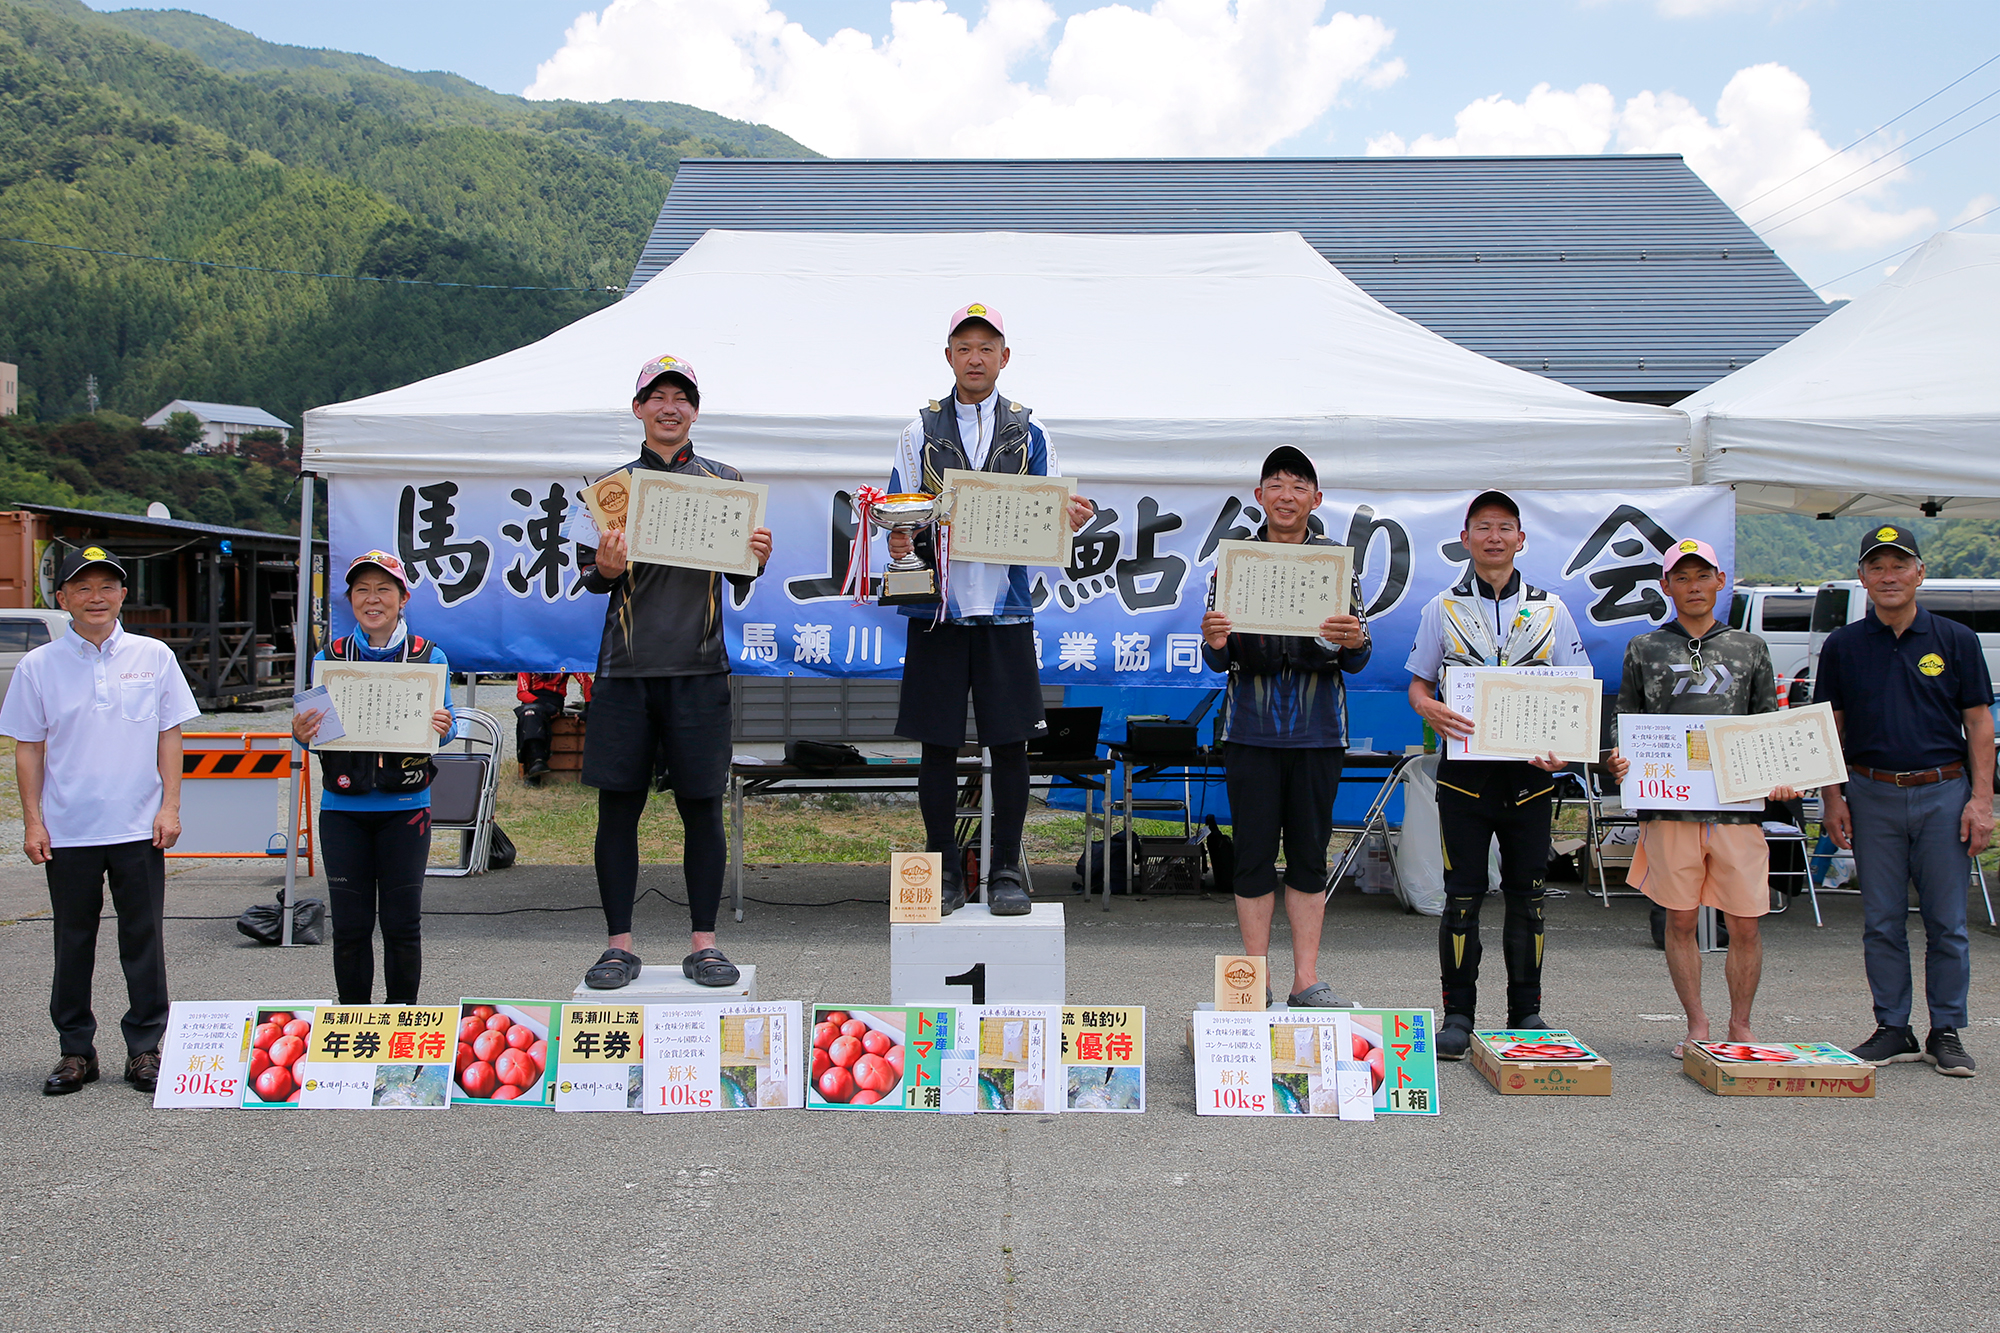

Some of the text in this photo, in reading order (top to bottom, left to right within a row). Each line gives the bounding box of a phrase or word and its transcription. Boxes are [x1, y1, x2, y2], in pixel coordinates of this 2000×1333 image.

[908, 462, 918, 489] PRO
[720, 505, 728, 524] 準優勝
[1033, 500, 1040, 518] 優勝
[1042, 505, 1053, 531] 賞状
[730, 511, 742, 538] 賞状
[1319, 575, 1329, 602] 賞状
[414, 692, 423, 718] 賞状
[1570, 705, 1580, 729] 賞状
[1631, 733, 1677, 741] 米・食味分析鑑定
[1807, 731, 1820, 754] 賞状
[1635, 751, 1672, 759] 『金賞』受賞米
[1643, 763, 1676, 778] 新米
[1638, 779, 1691, 801] 10kg
[898, 887, 933, 903] 優勝
[945, 963, 985, 1004] 1
[1227, 993, 1253, 1004] 三位
[181, 1022, 234, 1031] 米・食味分析鑑定
[322, 1011, 444, 1027] 馬瀬川上流 鮎釣り
[571, 1010, 639, 1025] 馬瀬川上流
[654, 1022, 706, 1031] 米・食味分析鑑定
[1081, 1011, 1128, 1028] 鮎釣り
[179, 1032, 239, 1040] コンクール国際大会
[653, 1035, 712, 1044] コンクール国際大会
[935, 1012, 948, 1051] 馬瀬産
[1205, 1028, 1256, 1037] 米・食味分析鑑定
[1412, 1015, 1427, 1053] 馬瀬産
[181, 1042, 225, 1050] 『金賞』受賞米
[322, 1031, 446, 1059] 年券 優待
[572, 1031, 632, 1059] 年券
[658, 1048, 706, 1059] 『金賞』受賞米
[771, 1019, 783, 1079] 馬瀬ひかり
[912, 1012, 934, 1087] トマト
[1030, 1021, 1042, 1084] 馬瀬ひかり
[1075, 1031, 1134, 1062] 優待
[1205, 1041, 1262, 1050] コンクール国際大会
[1391, 1014, 1413, 1089] トマト
[187, 1055, 225, 1072] 新米
[1211, 1054, 1257, 1063] 『金賞』受賞米
[1322, 1031, 1333, 1087] 馬瀬ひかり
[667, 1065, 697, 1081] 新米
[1219, 1070, 1250, 1086] 新米
[174, 1073, 238, 1097] 30kg
[658, 1085, 714, 1108] 10kg
[1212, 1088, 1266, 1112] 10kg
[1390, 1089, 1428, 1110] 1箱
